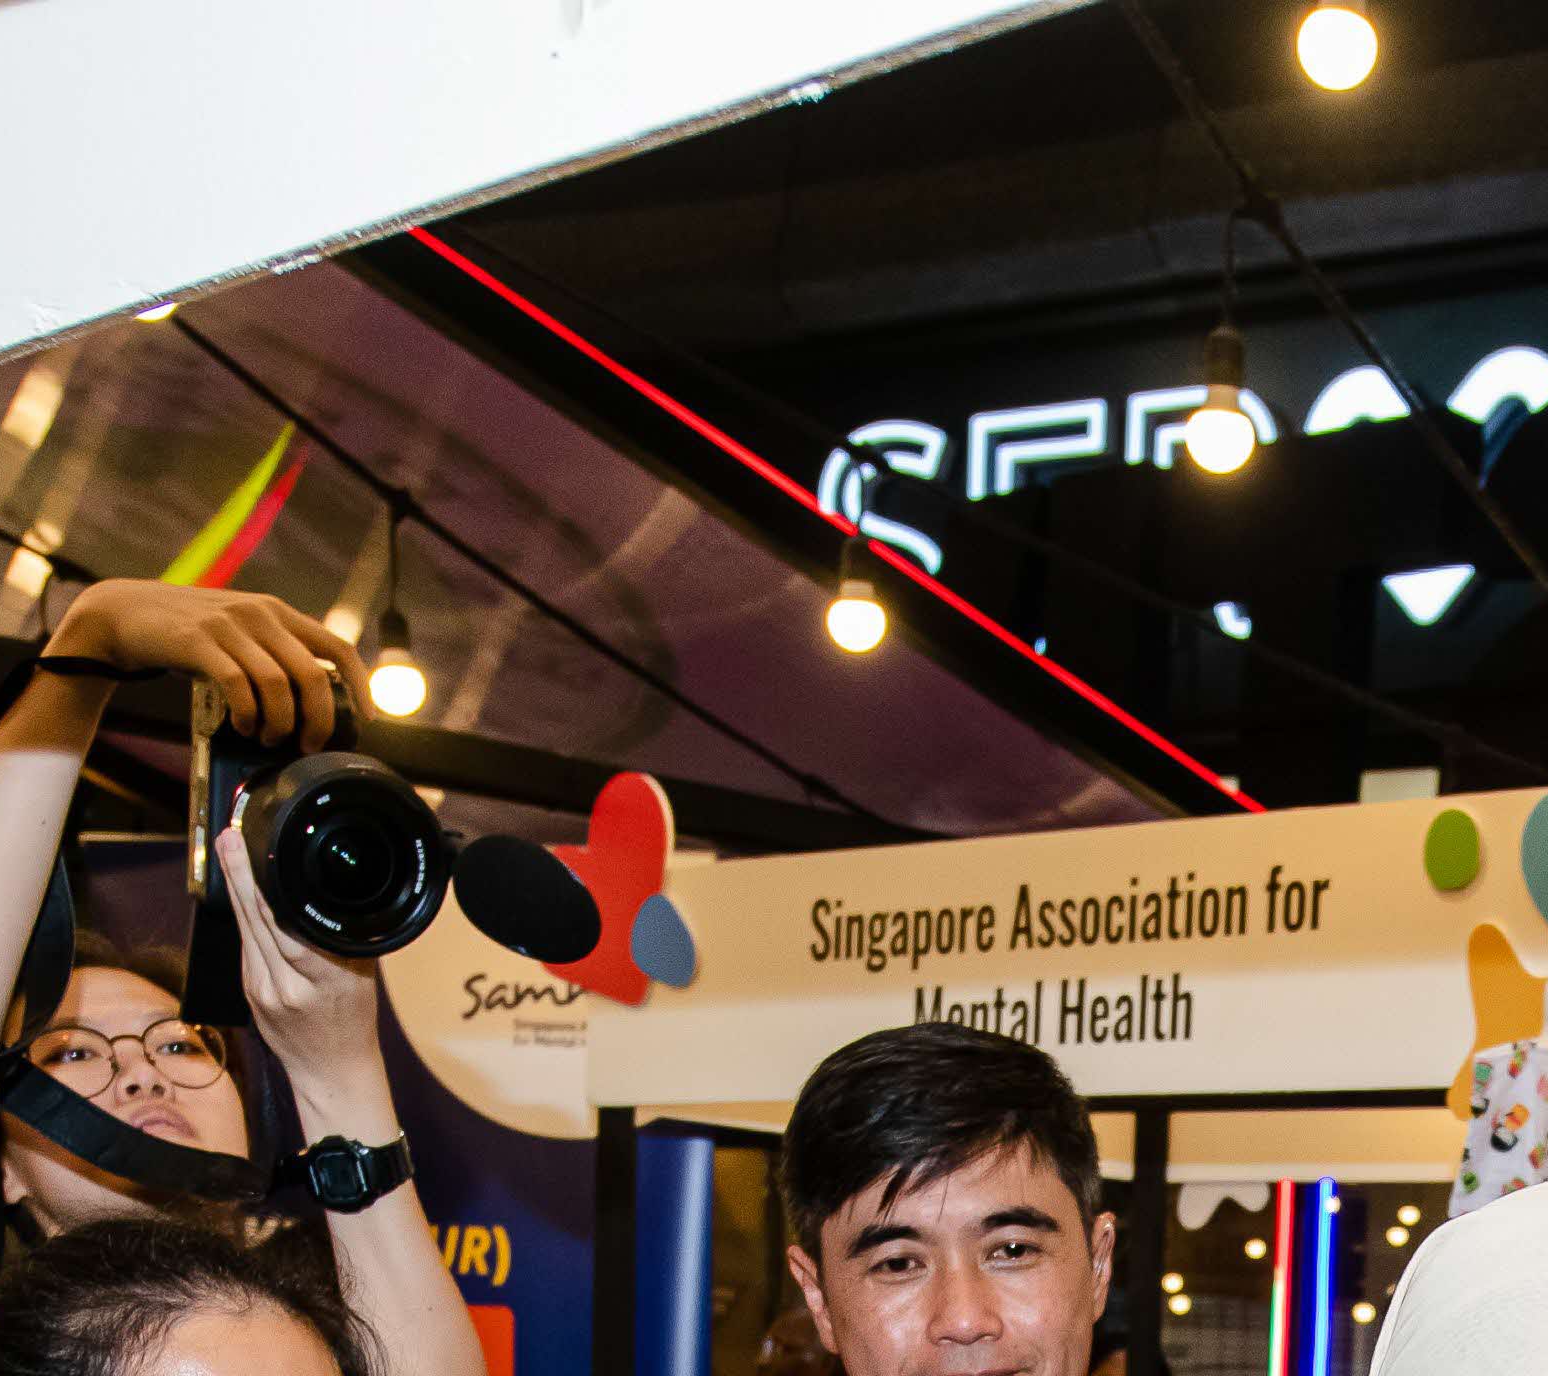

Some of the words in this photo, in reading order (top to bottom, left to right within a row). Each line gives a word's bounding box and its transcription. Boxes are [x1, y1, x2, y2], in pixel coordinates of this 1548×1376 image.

[810, 897, 995, 973] Singapore
[1010, 871, 1248, 951] Association
[1266, 865, 1331, 934] for
[1058, 973, 1197, 1046] Health
